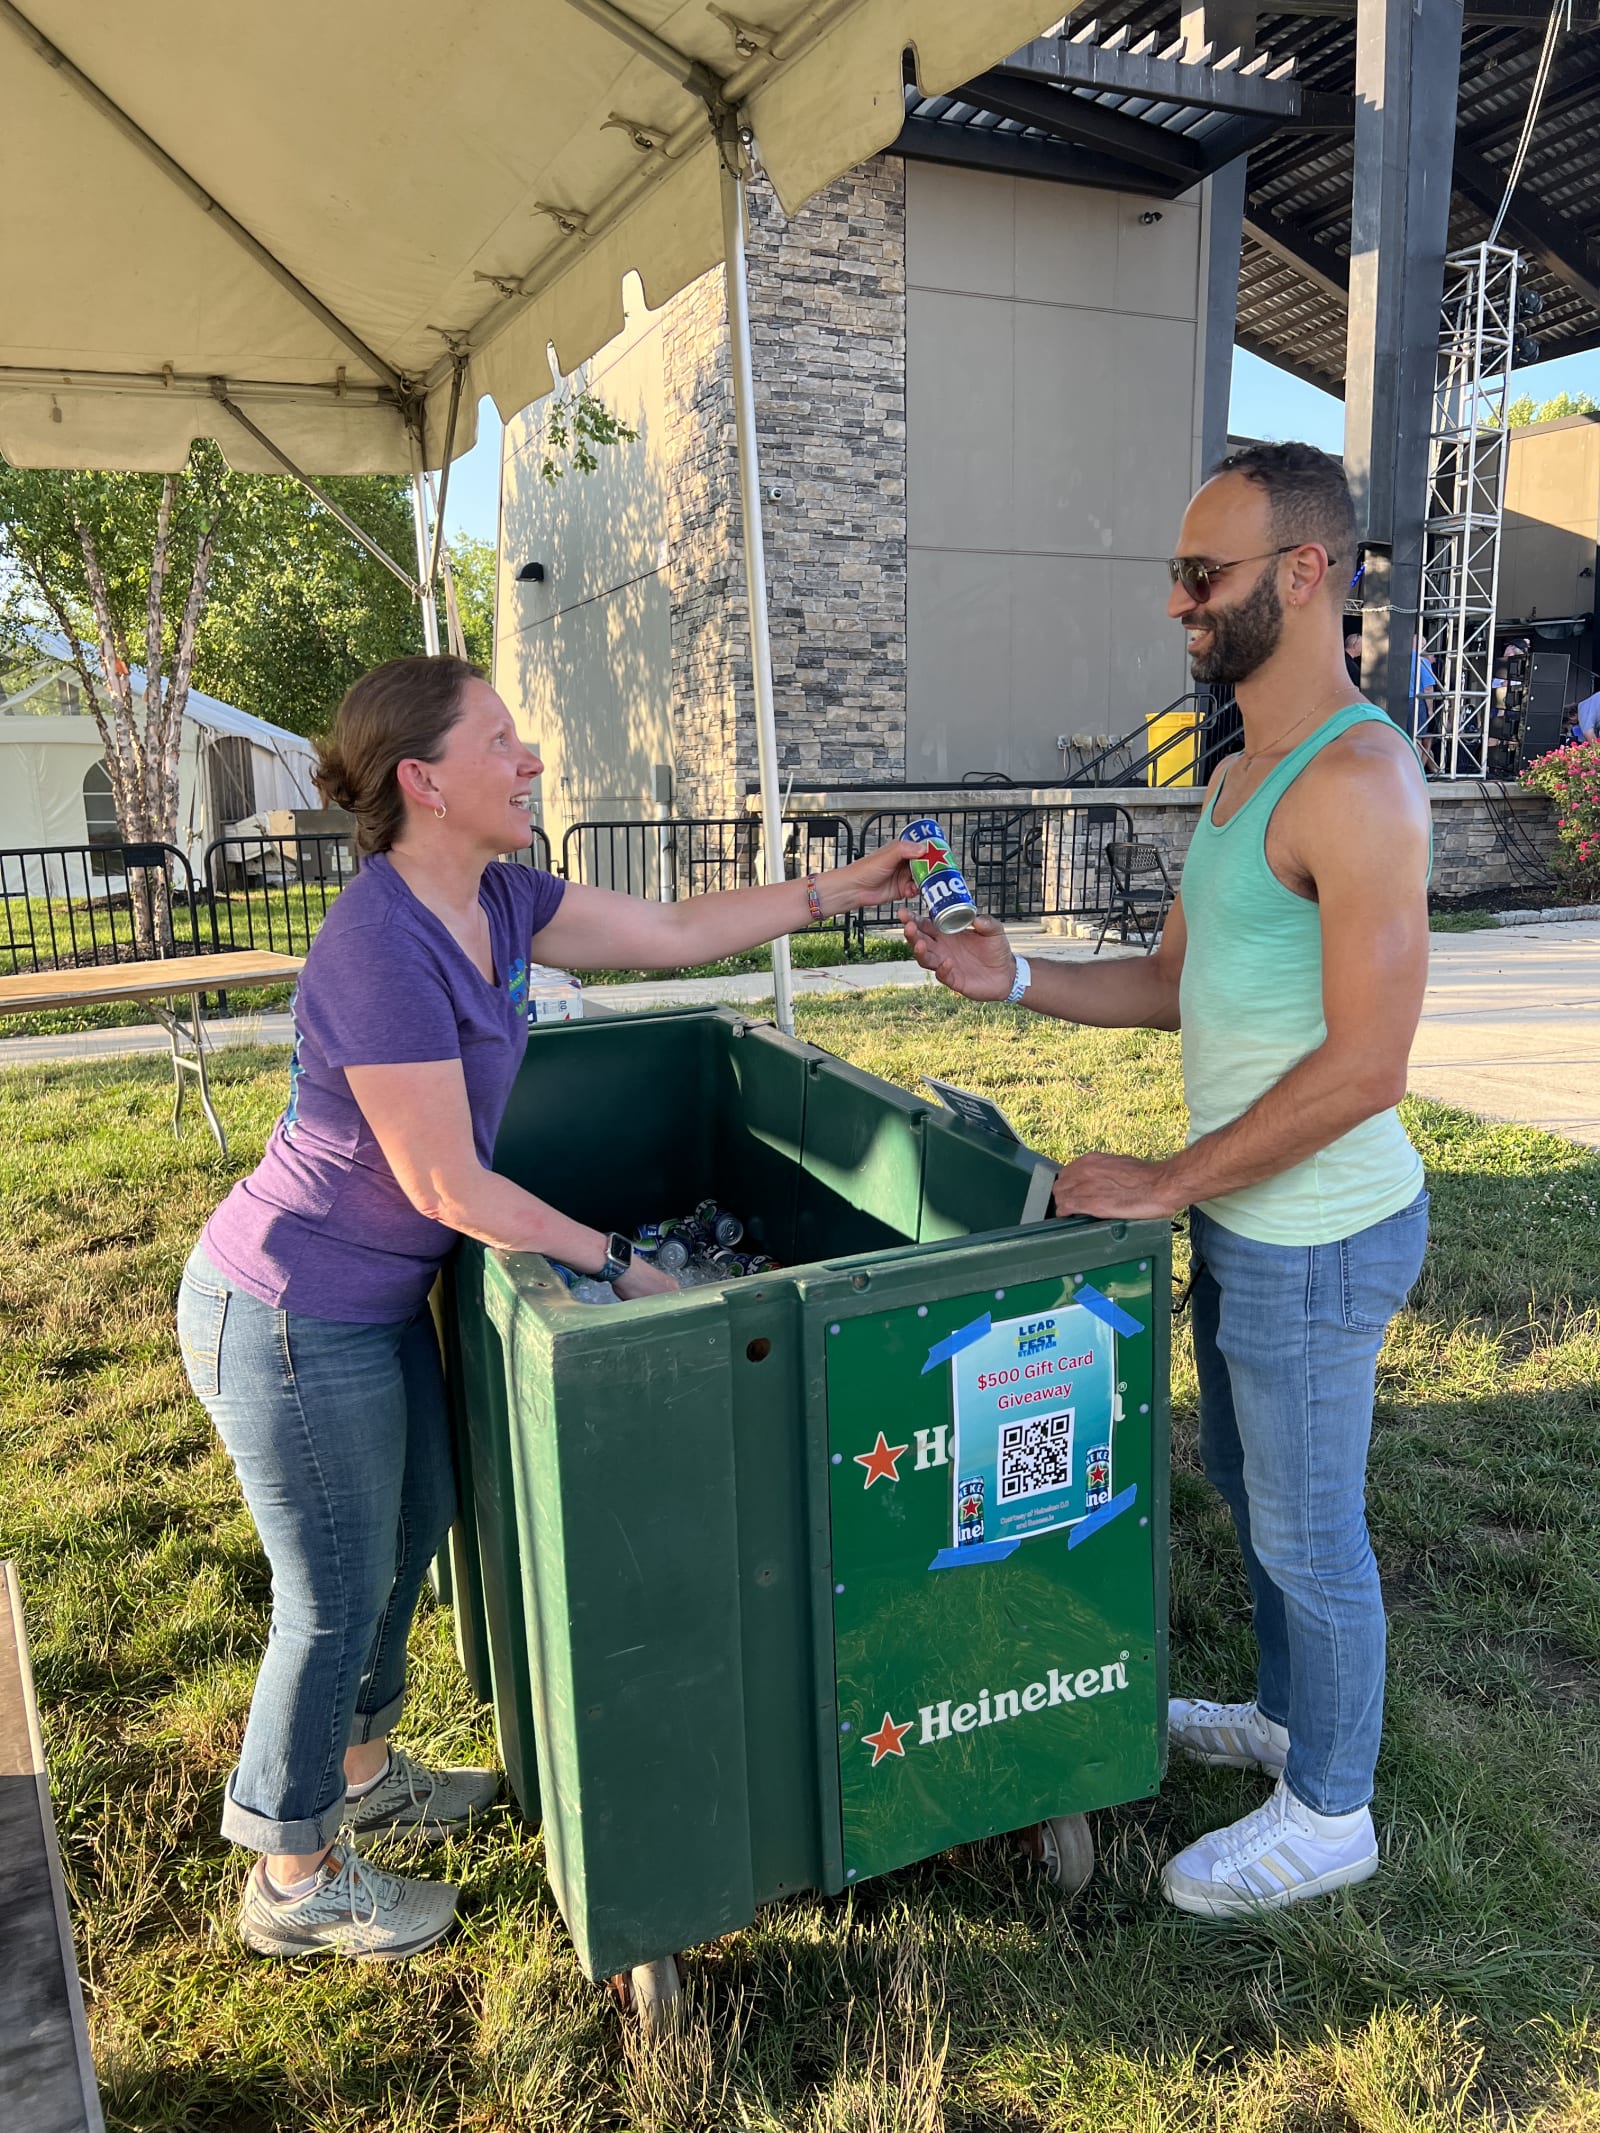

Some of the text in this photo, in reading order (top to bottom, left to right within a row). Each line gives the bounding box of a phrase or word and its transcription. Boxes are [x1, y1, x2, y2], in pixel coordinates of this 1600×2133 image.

[1019, 1319, 1056, 1336] LEAD
[977, 1350, 1094, 1391] $500 Gift Card
[998, 1382, 1073, 1409] Giveaway
[918, 1661, 1129, 1745] Heineken
